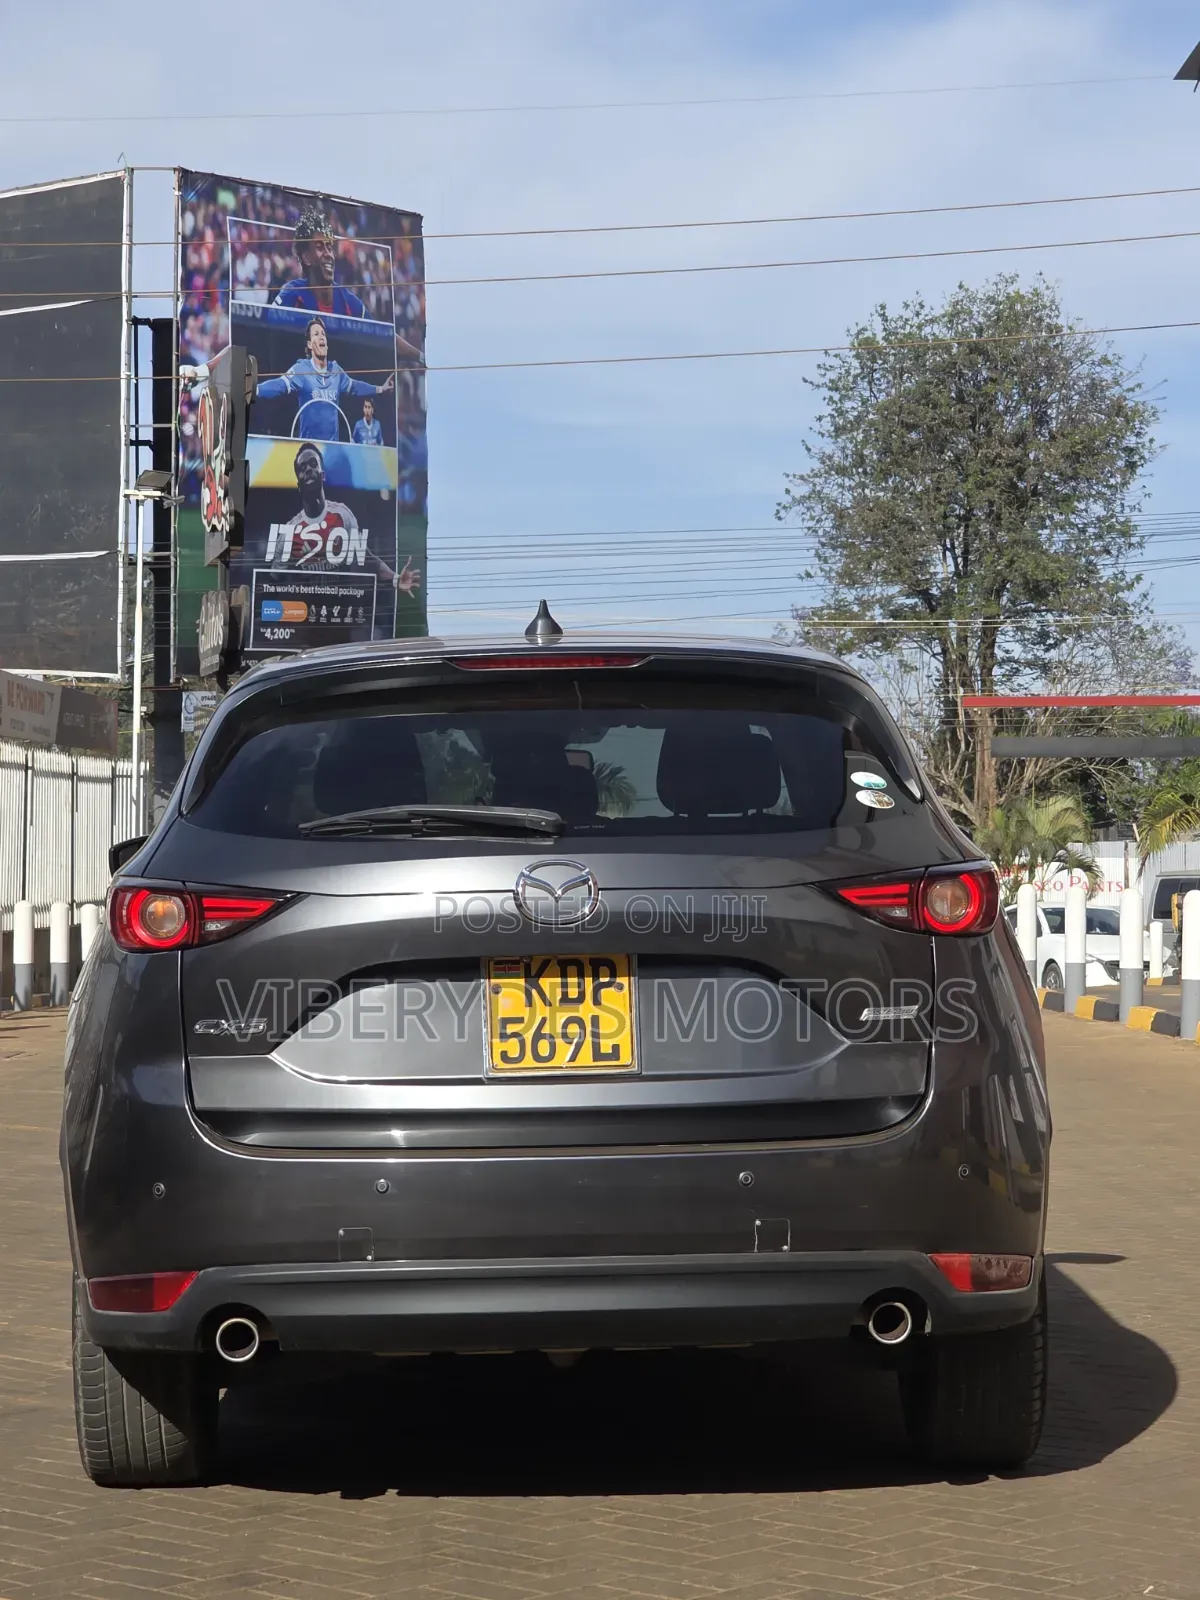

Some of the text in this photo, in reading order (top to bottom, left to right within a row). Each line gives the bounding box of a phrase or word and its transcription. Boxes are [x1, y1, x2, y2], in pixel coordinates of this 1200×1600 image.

[264, 520, 369, 567] IT'S ON
[262, 583, 365, 598] The world's best football package
[264, 628, 291, 641] 4,200
[523, 957, 618, 1007] KDP
[499, 1014, 621, 1065] 569L
